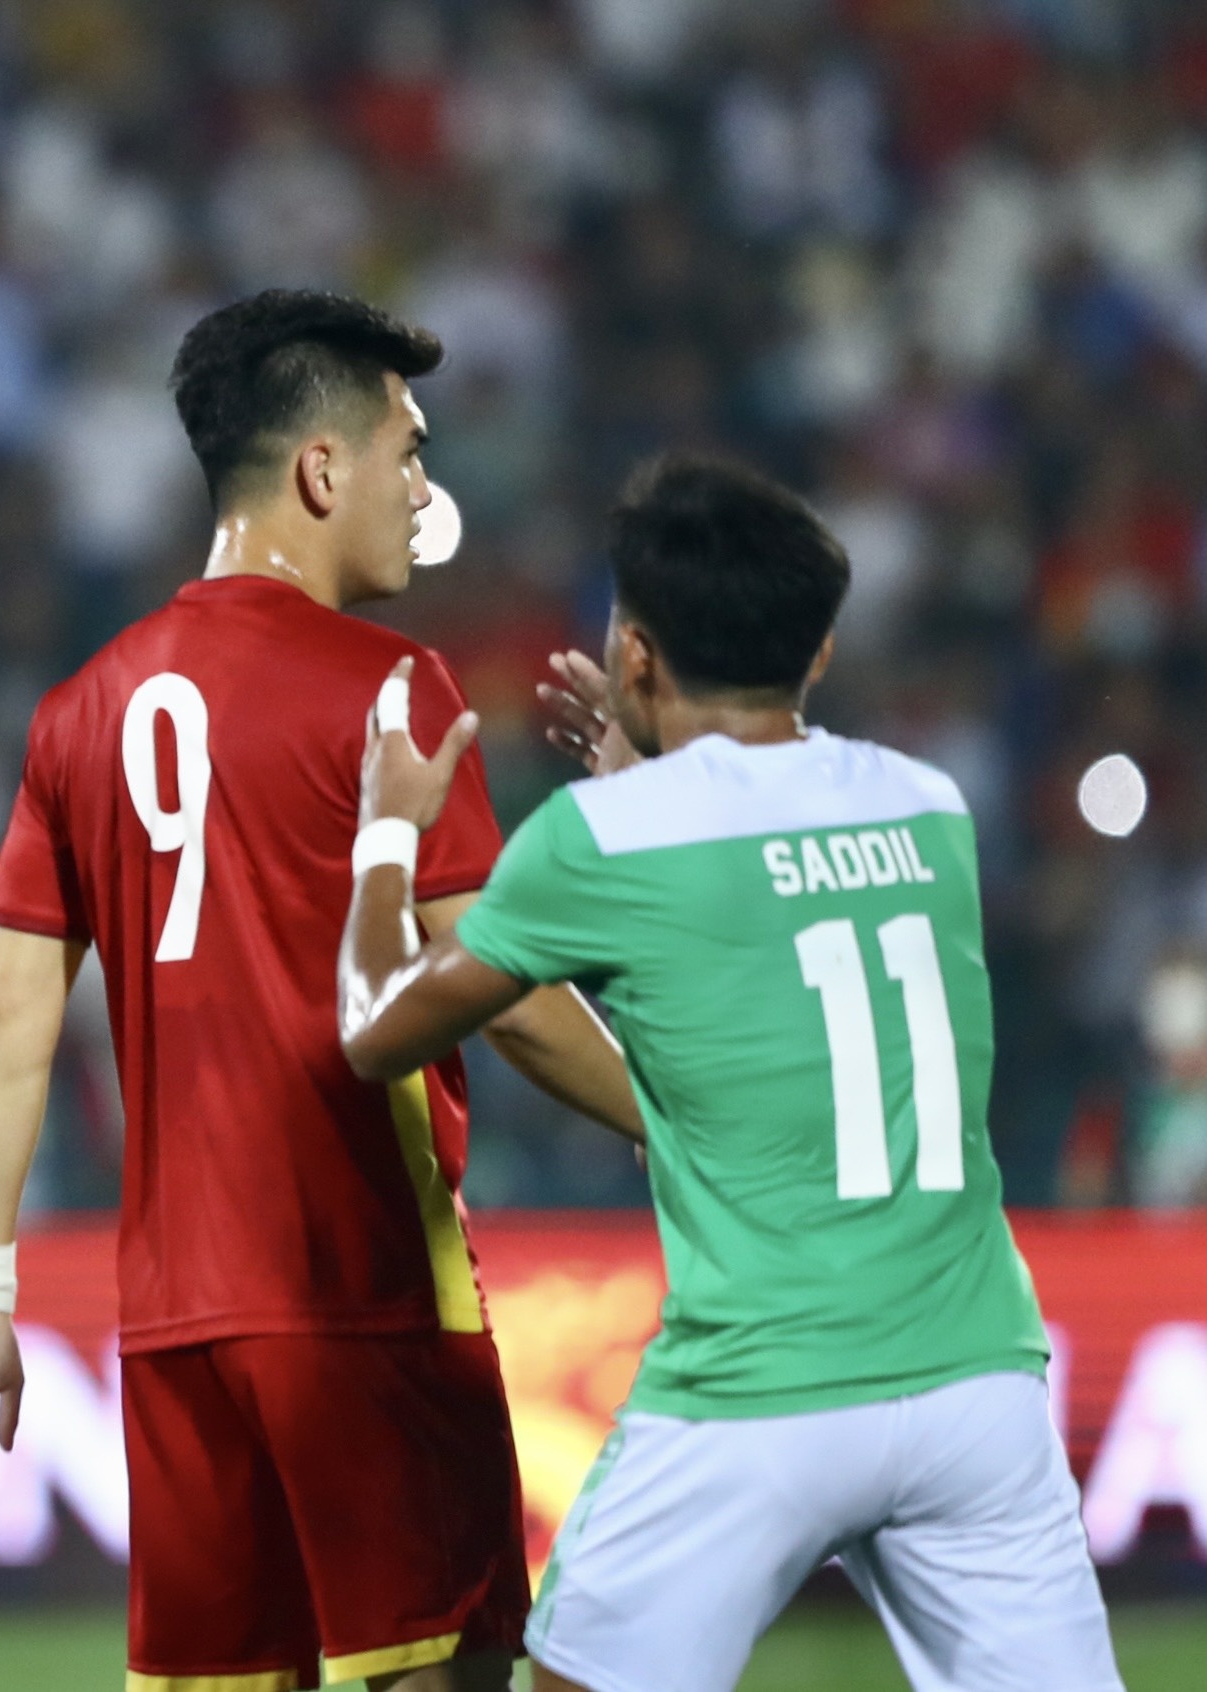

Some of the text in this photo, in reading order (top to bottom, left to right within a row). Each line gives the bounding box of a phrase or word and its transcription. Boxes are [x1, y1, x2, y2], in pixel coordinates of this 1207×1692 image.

[121, 672, 212, 963] 9
[762, 826, 935, 897] SADDIL
[794, 913, 965, 1200] 11
